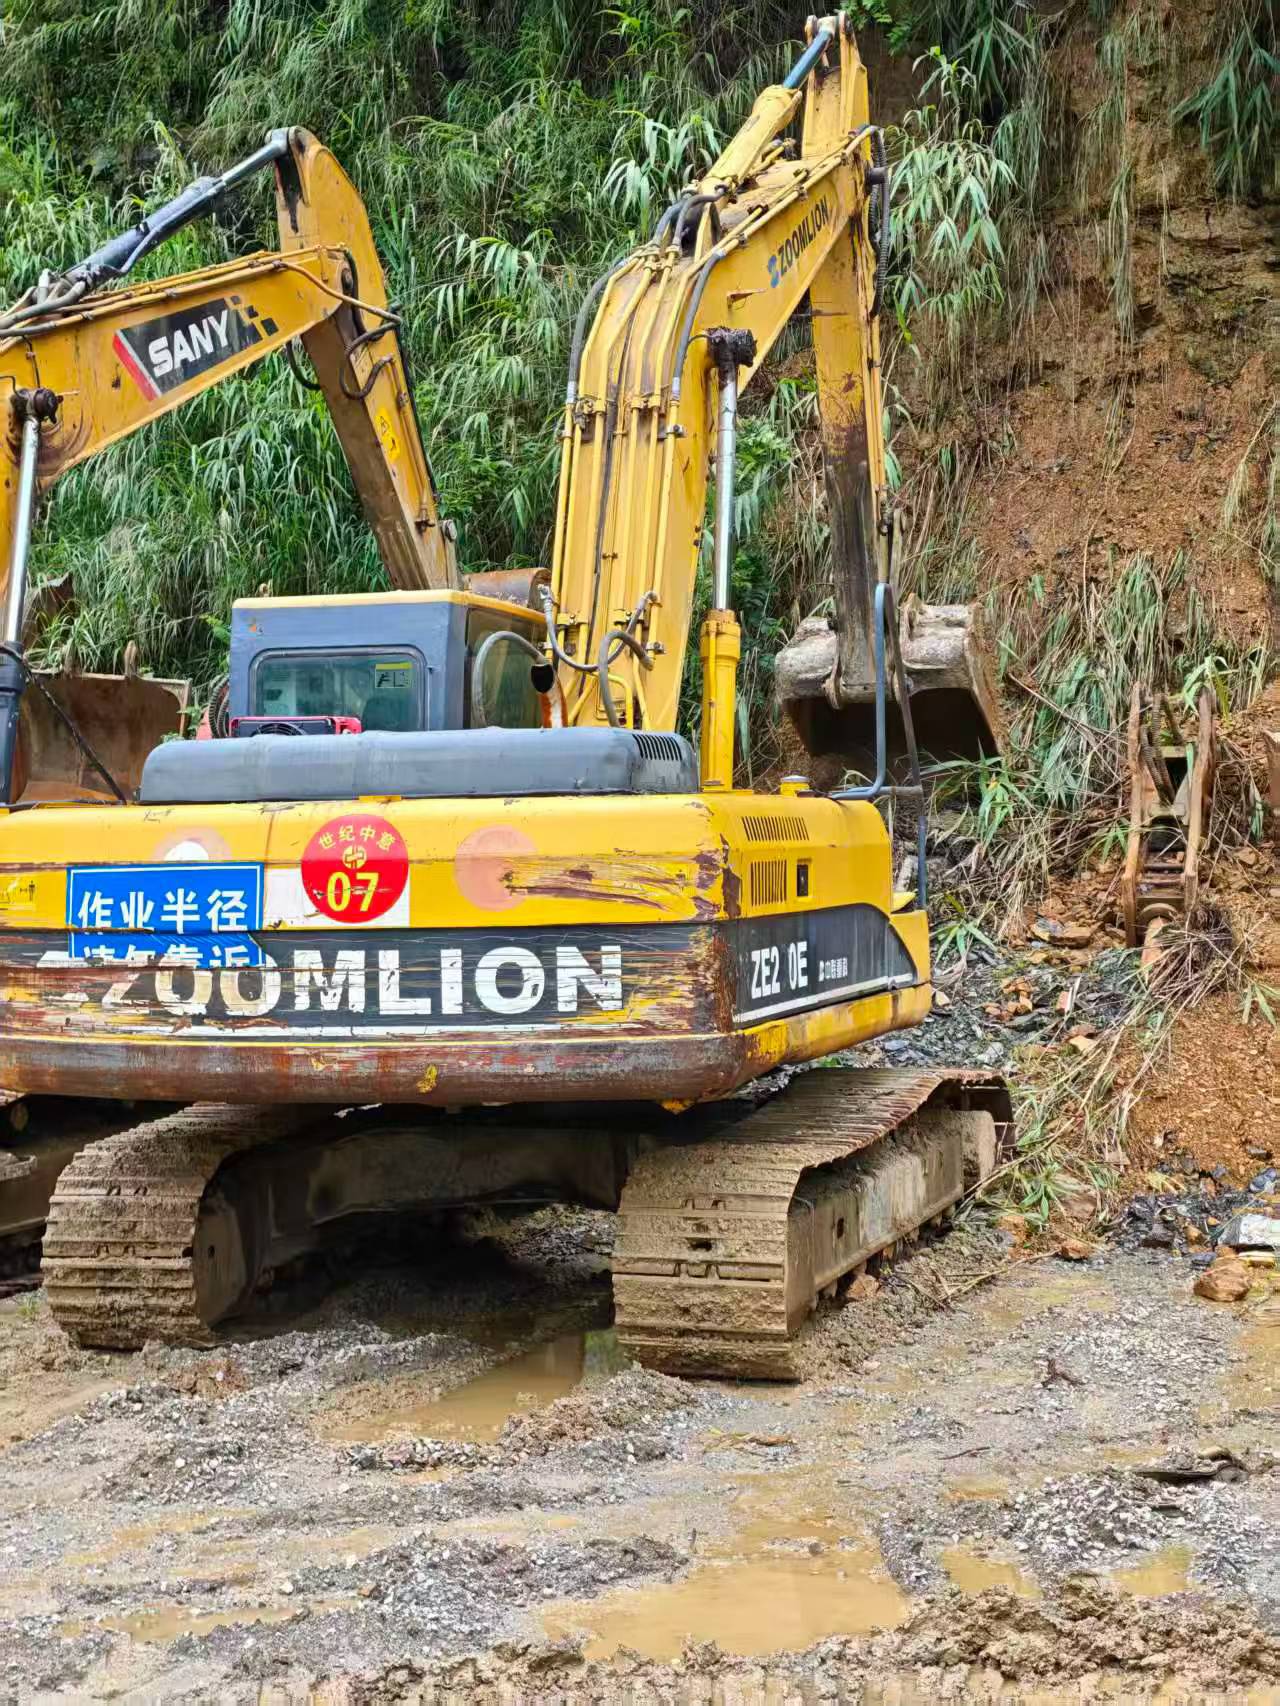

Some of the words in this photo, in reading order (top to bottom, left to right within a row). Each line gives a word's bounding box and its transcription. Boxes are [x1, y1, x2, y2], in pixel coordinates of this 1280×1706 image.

[778, 194, 829, 277] ZOOMLION
[149, 309, 229, 377] SANY
[78, 888, 248, 935] 作业半径
[327, 871, 379, 912] 07
[100, 946, 623, 1016] ZOOMLION
